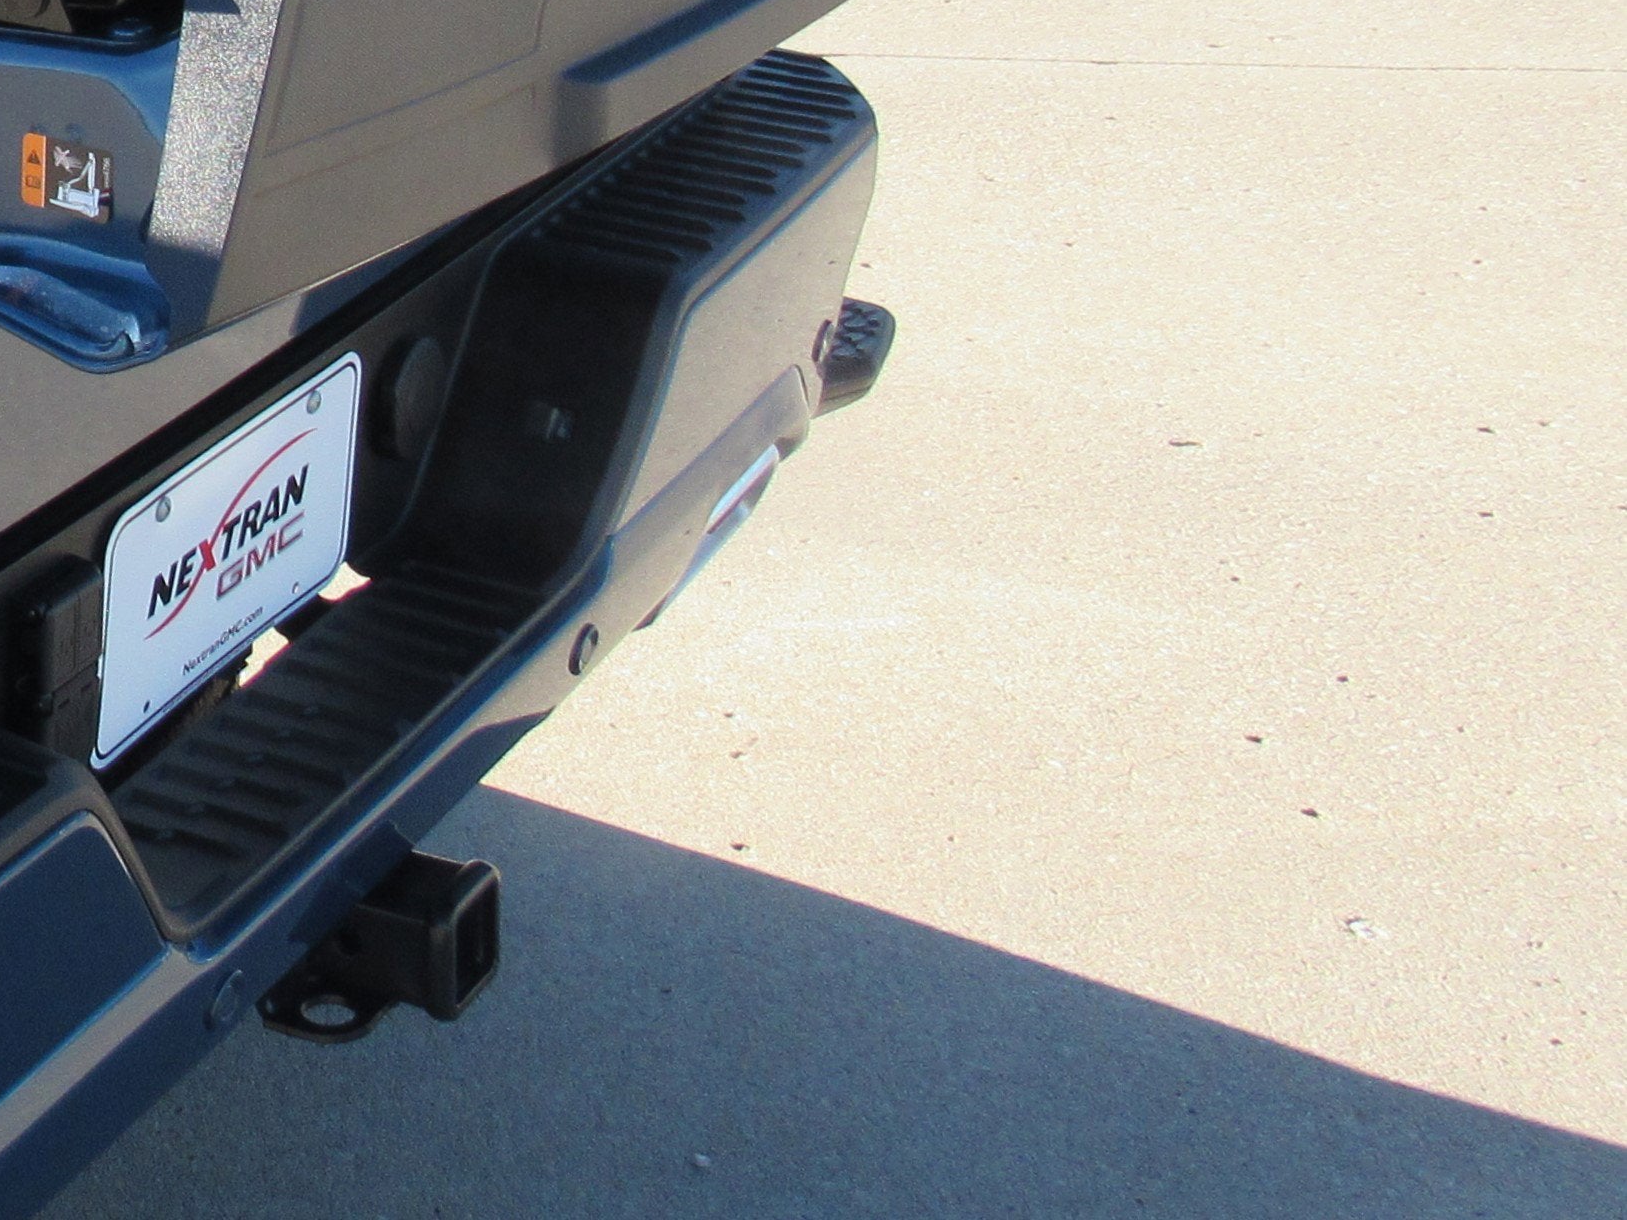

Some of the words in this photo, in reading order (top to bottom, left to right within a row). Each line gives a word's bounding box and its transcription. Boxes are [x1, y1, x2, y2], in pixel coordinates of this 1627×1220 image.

[147, 463, 310, 620] NEXTRAN
[215, 512, 305, 601] GMC
[182, 606, 264, 676] NextranGMC.com
